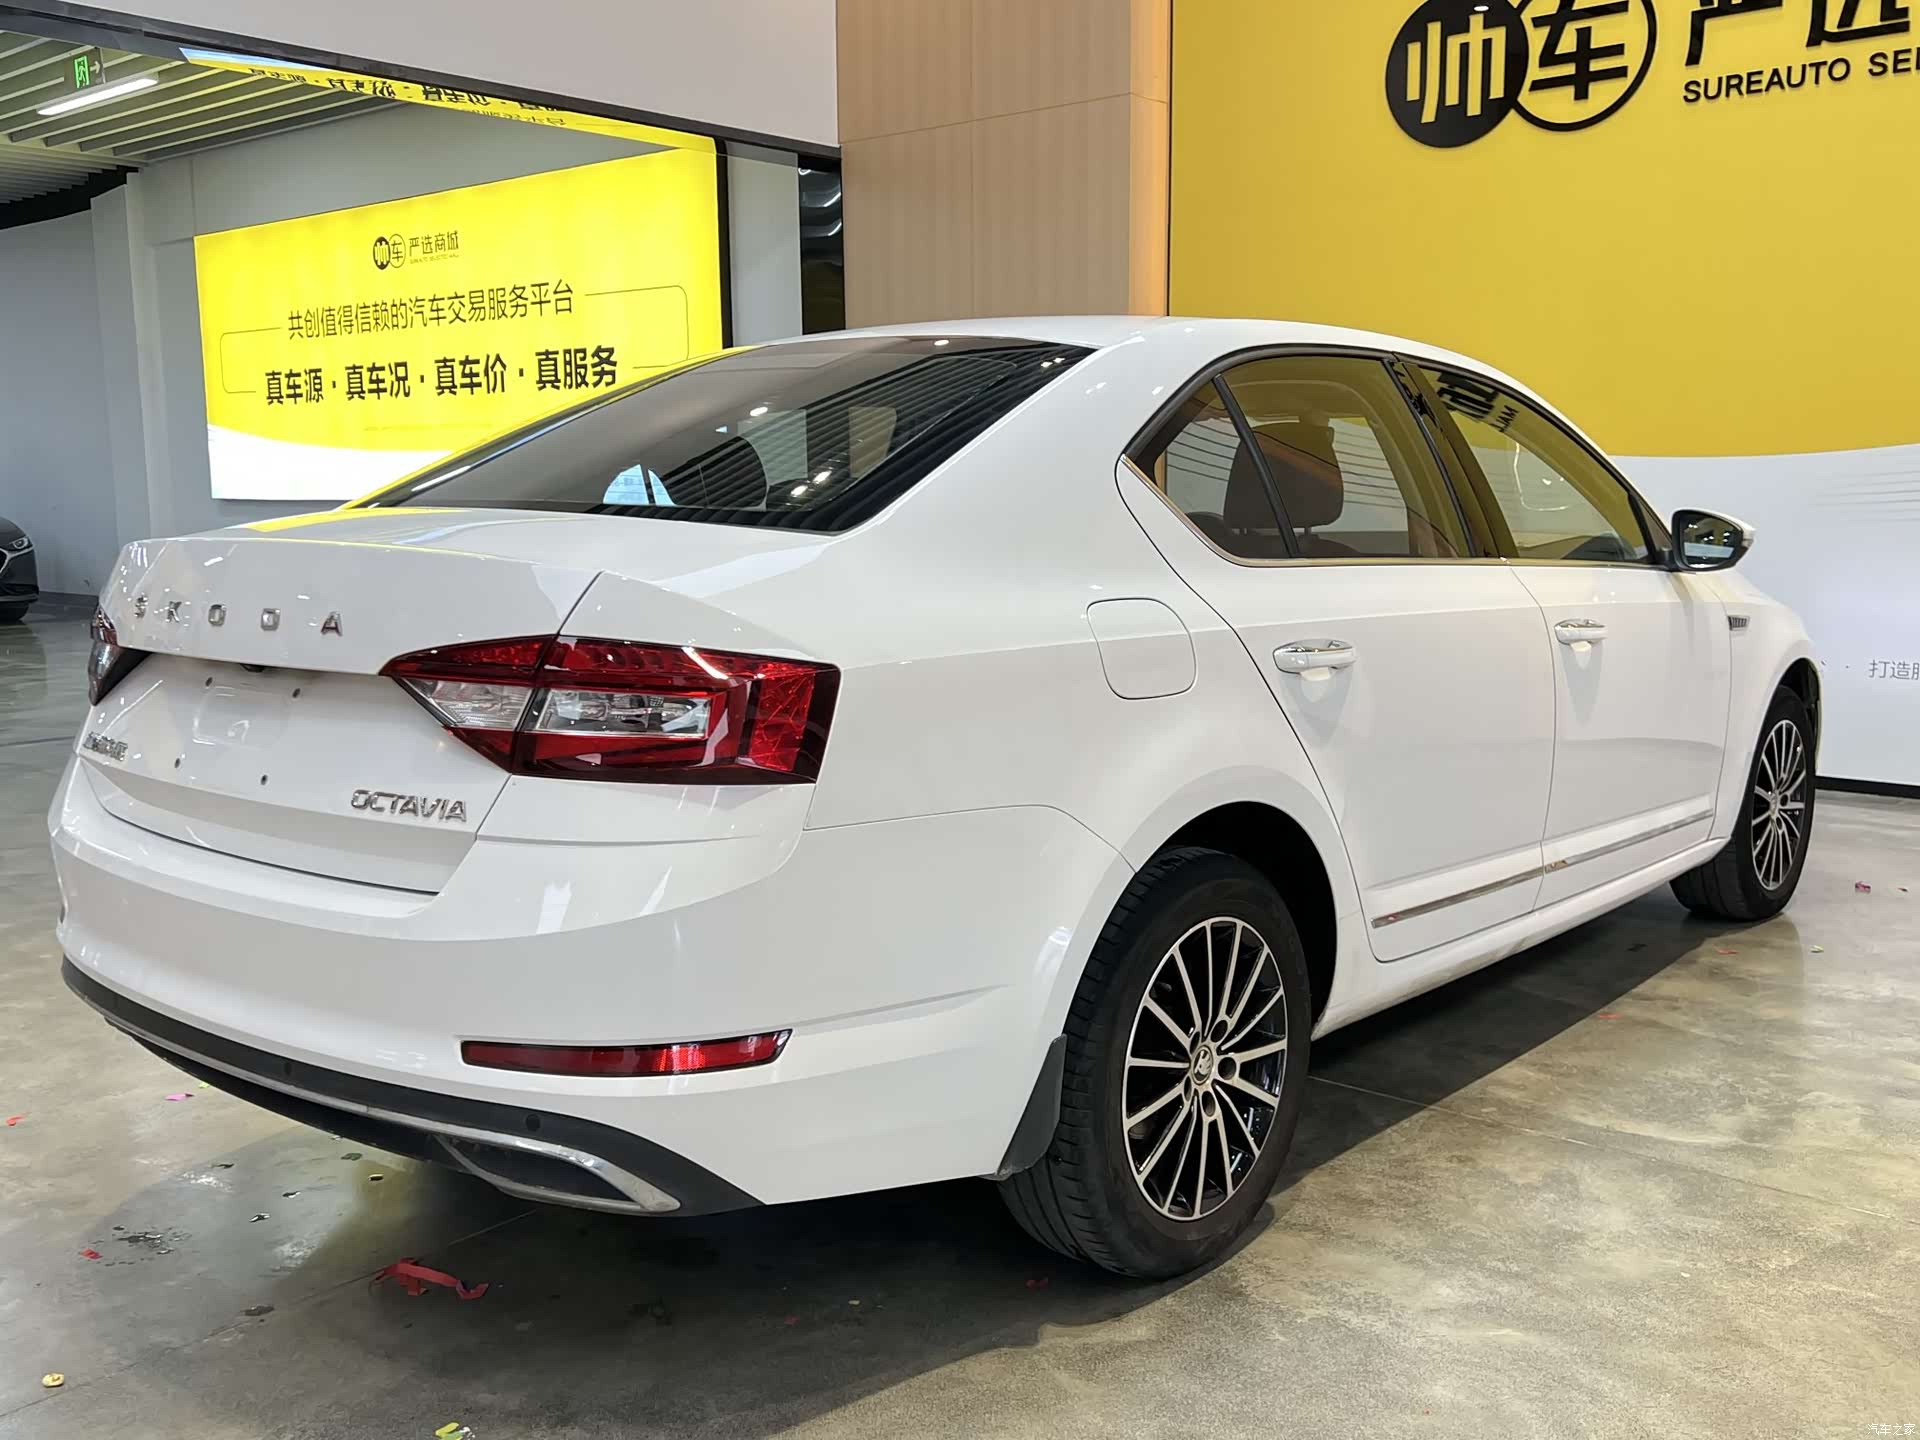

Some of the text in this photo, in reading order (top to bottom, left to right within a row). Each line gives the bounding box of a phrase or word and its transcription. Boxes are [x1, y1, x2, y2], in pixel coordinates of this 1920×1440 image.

[1683, 46, 1920, 103] SUREAUTO SE
[288, 279, 574, 340] 共创值得信赖的汽车交易服务平台
[351, 789, 467, 823] OCTAVIA
